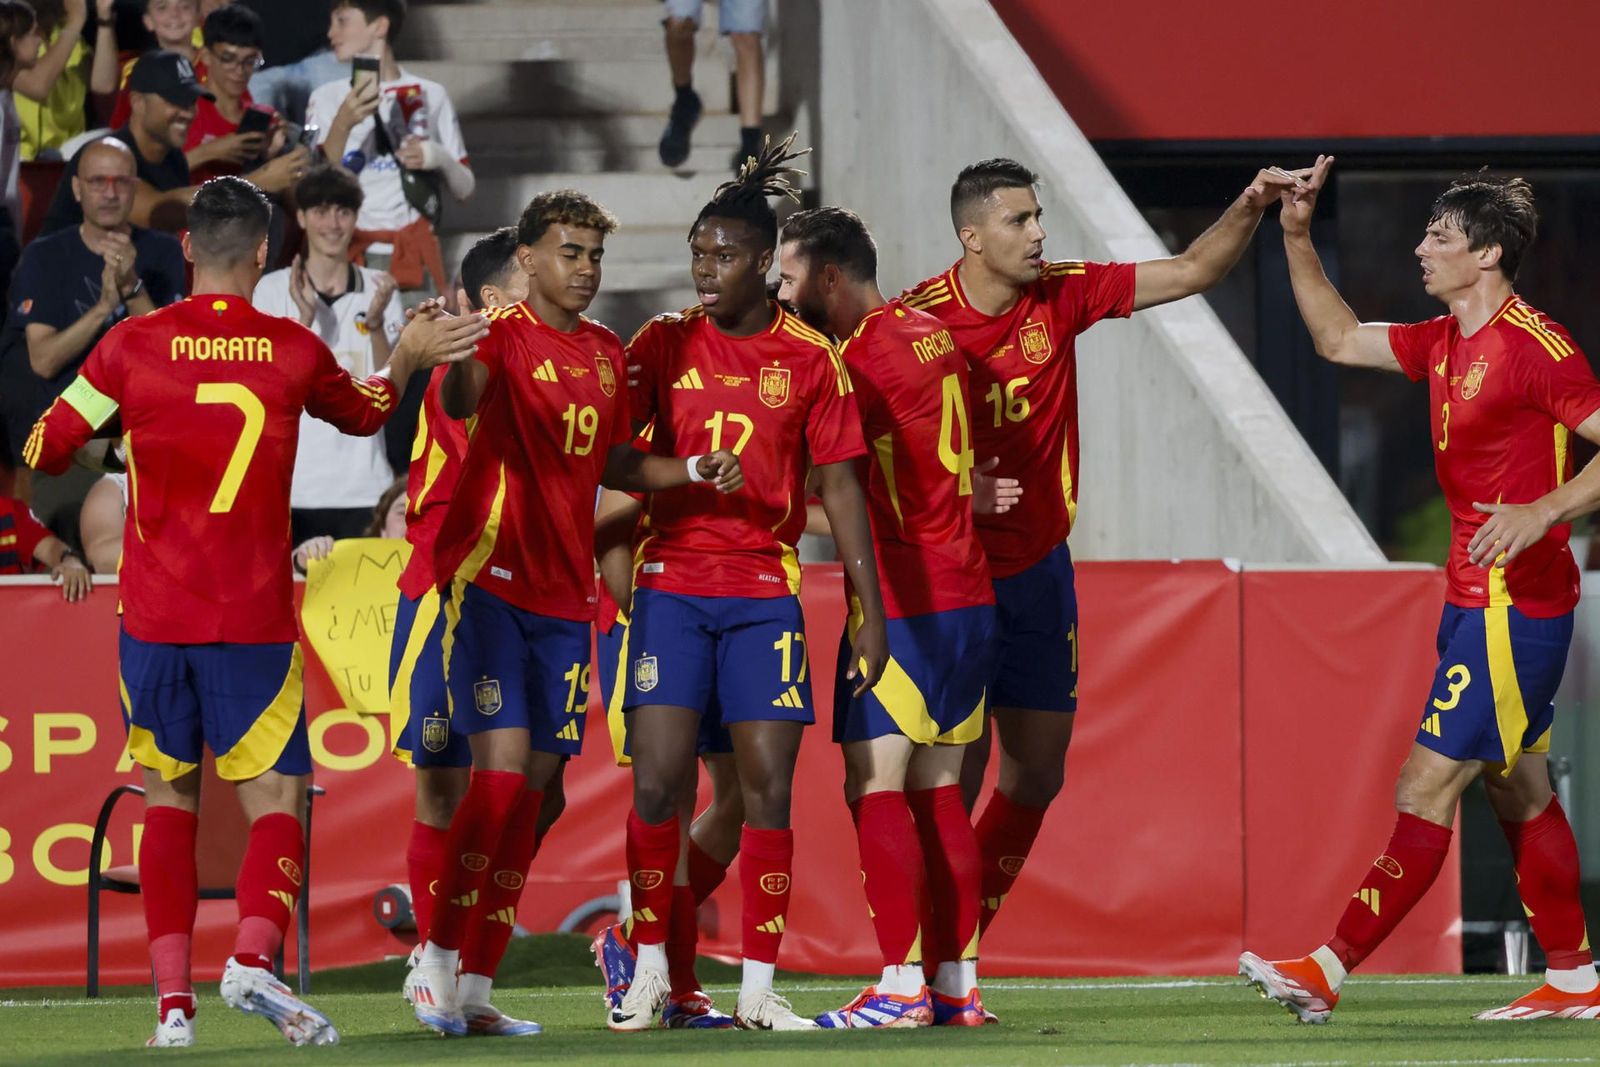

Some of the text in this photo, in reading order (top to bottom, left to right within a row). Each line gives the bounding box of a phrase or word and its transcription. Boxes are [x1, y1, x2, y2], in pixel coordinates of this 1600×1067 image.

[171, 335, 273, 363] MORATA
[911, 329, 955, 364] NACHO
[985, 376, 1031, 428] 16
[1438, 401, 1450, 451] 3
[195, 382, 266, 514] 7
[562, 403, 599, 456] 19
[704, 410, 754, 456] 17
[938, 373, 975, 497] 4
[773, 631, 807, 683] 17
[564, 662, 592, 713] 19
[1433, 664, 1472, 711] 3
